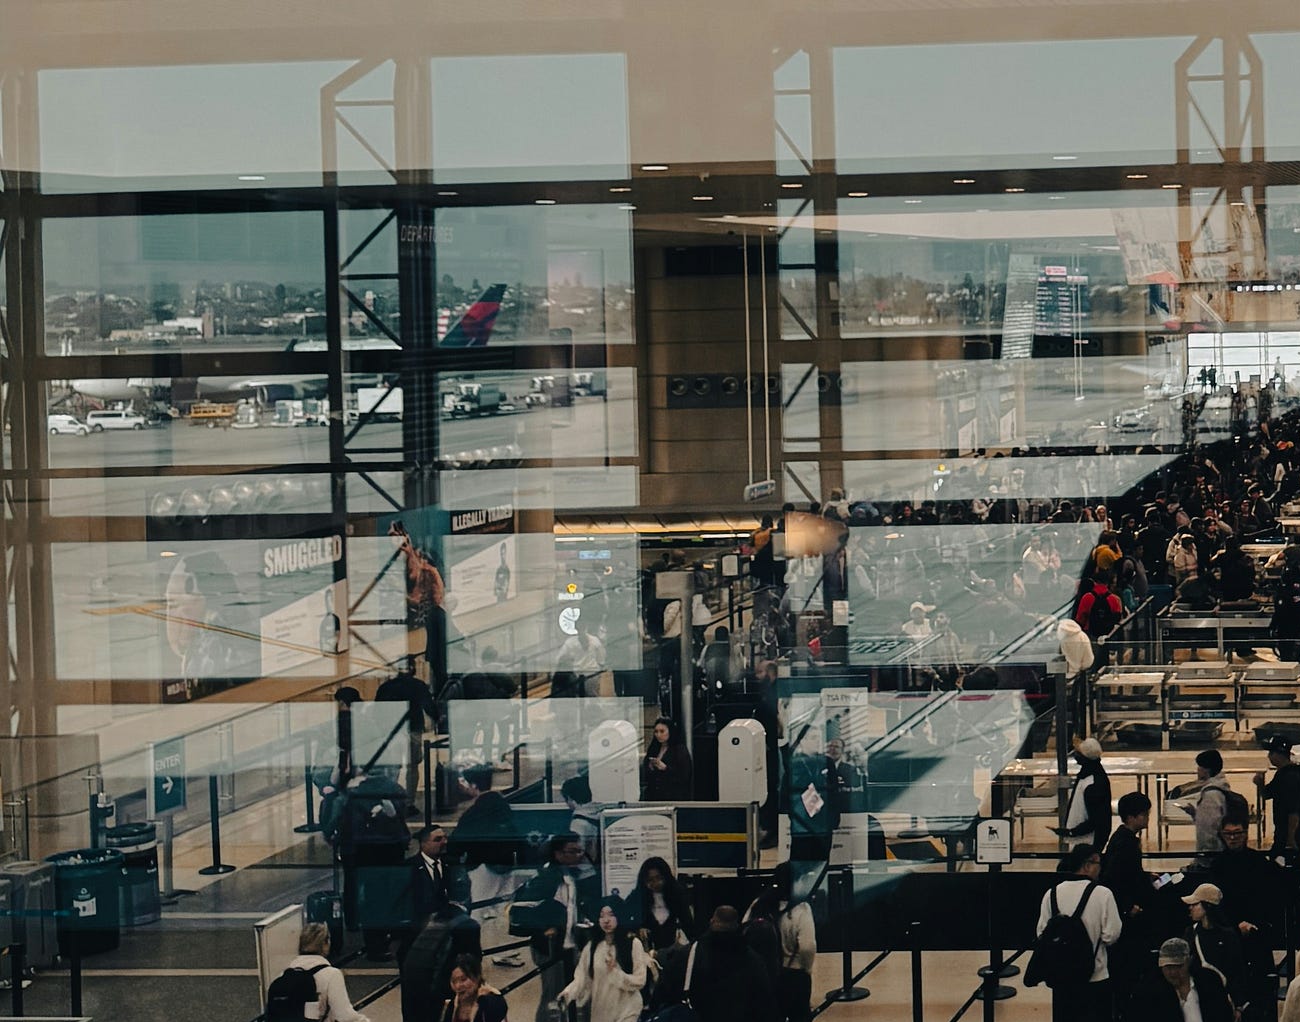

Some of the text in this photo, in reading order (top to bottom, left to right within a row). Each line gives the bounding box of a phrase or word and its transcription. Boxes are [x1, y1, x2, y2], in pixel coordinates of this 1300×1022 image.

[400, 225, 454, 243] DEPARTURES
[452, 509, 487, 531] ILLEGALLY
[264, 535, 342, 577] SMUGGLED
[155, 753, 180, 771] ENTER
